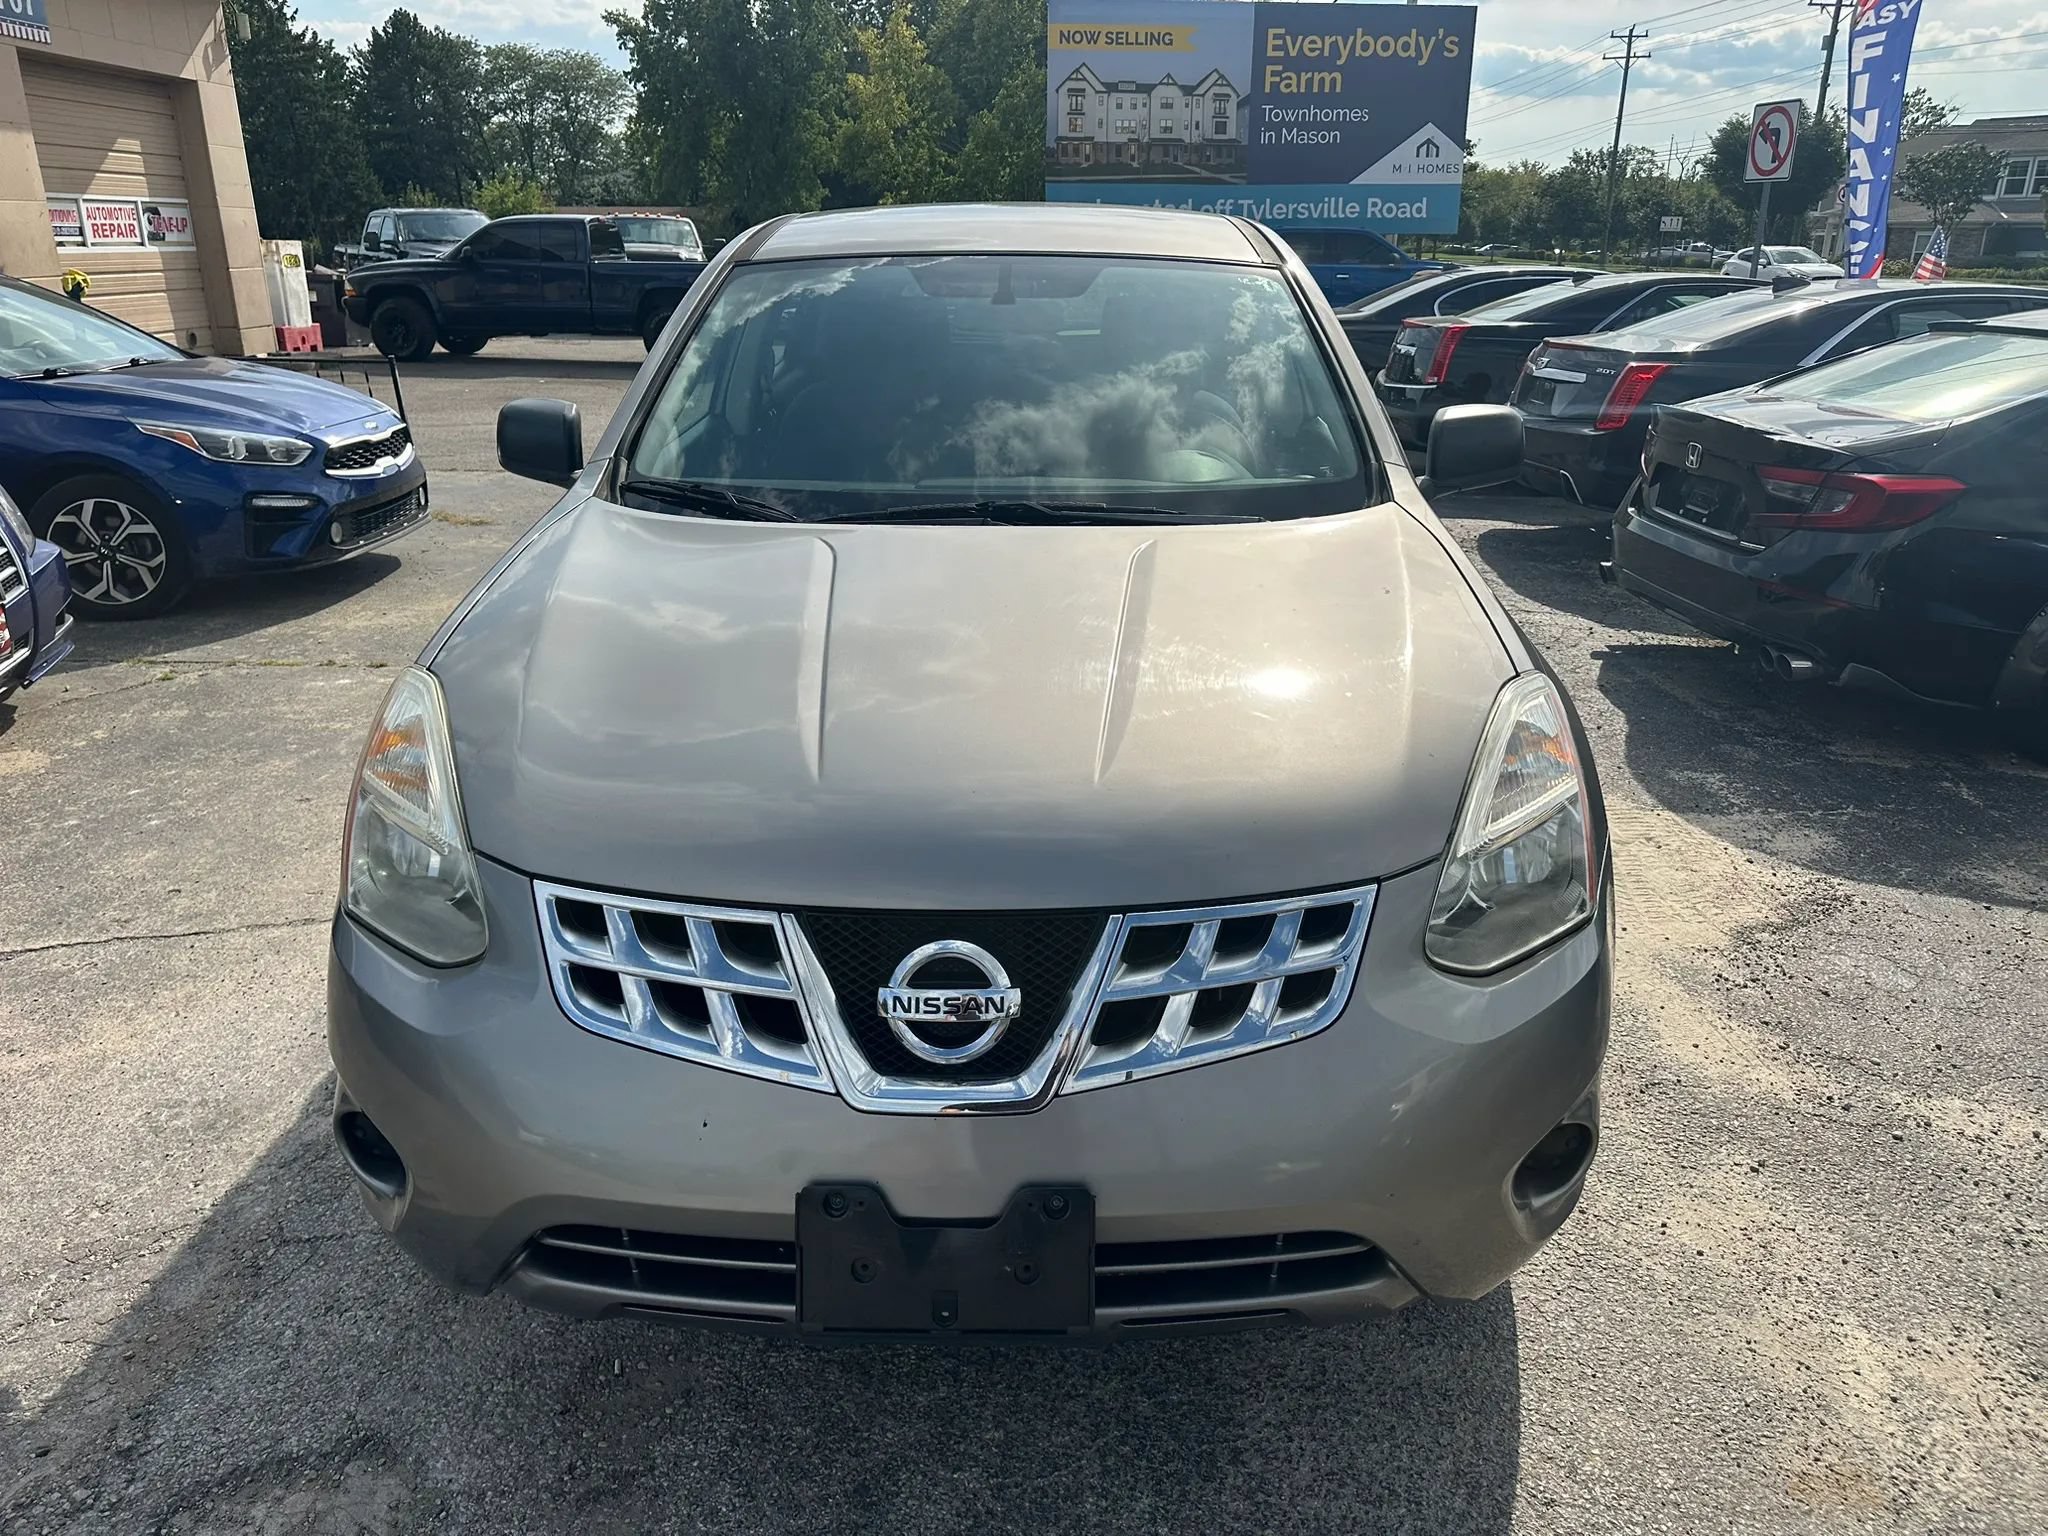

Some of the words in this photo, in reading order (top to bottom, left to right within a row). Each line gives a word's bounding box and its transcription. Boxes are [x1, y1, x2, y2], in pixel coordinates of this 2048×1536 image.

[1059, 30, 1101, 45] NOW
[1104, 31, 1173, 46] SELLING
[1266, 28, 1460, 66] Everybody's
[1264, 64, 1342, 93] Farm
[1261, 105, 1369, 122] Townhomes
[1260, 128, 1275, 144] in
[1281, 128, 1340, 144] Mason
[1417, 163, 1460, 174] HOMES
[86, 206, 137, 222] AUTOMOTIVE
[1237, 198, 1360, 221] Tylersville
[1366, 198, 1427, 219] Road
[91, 223, 138, 239] REPAIR
[892, 995, 1005, 1015] NISSAN
